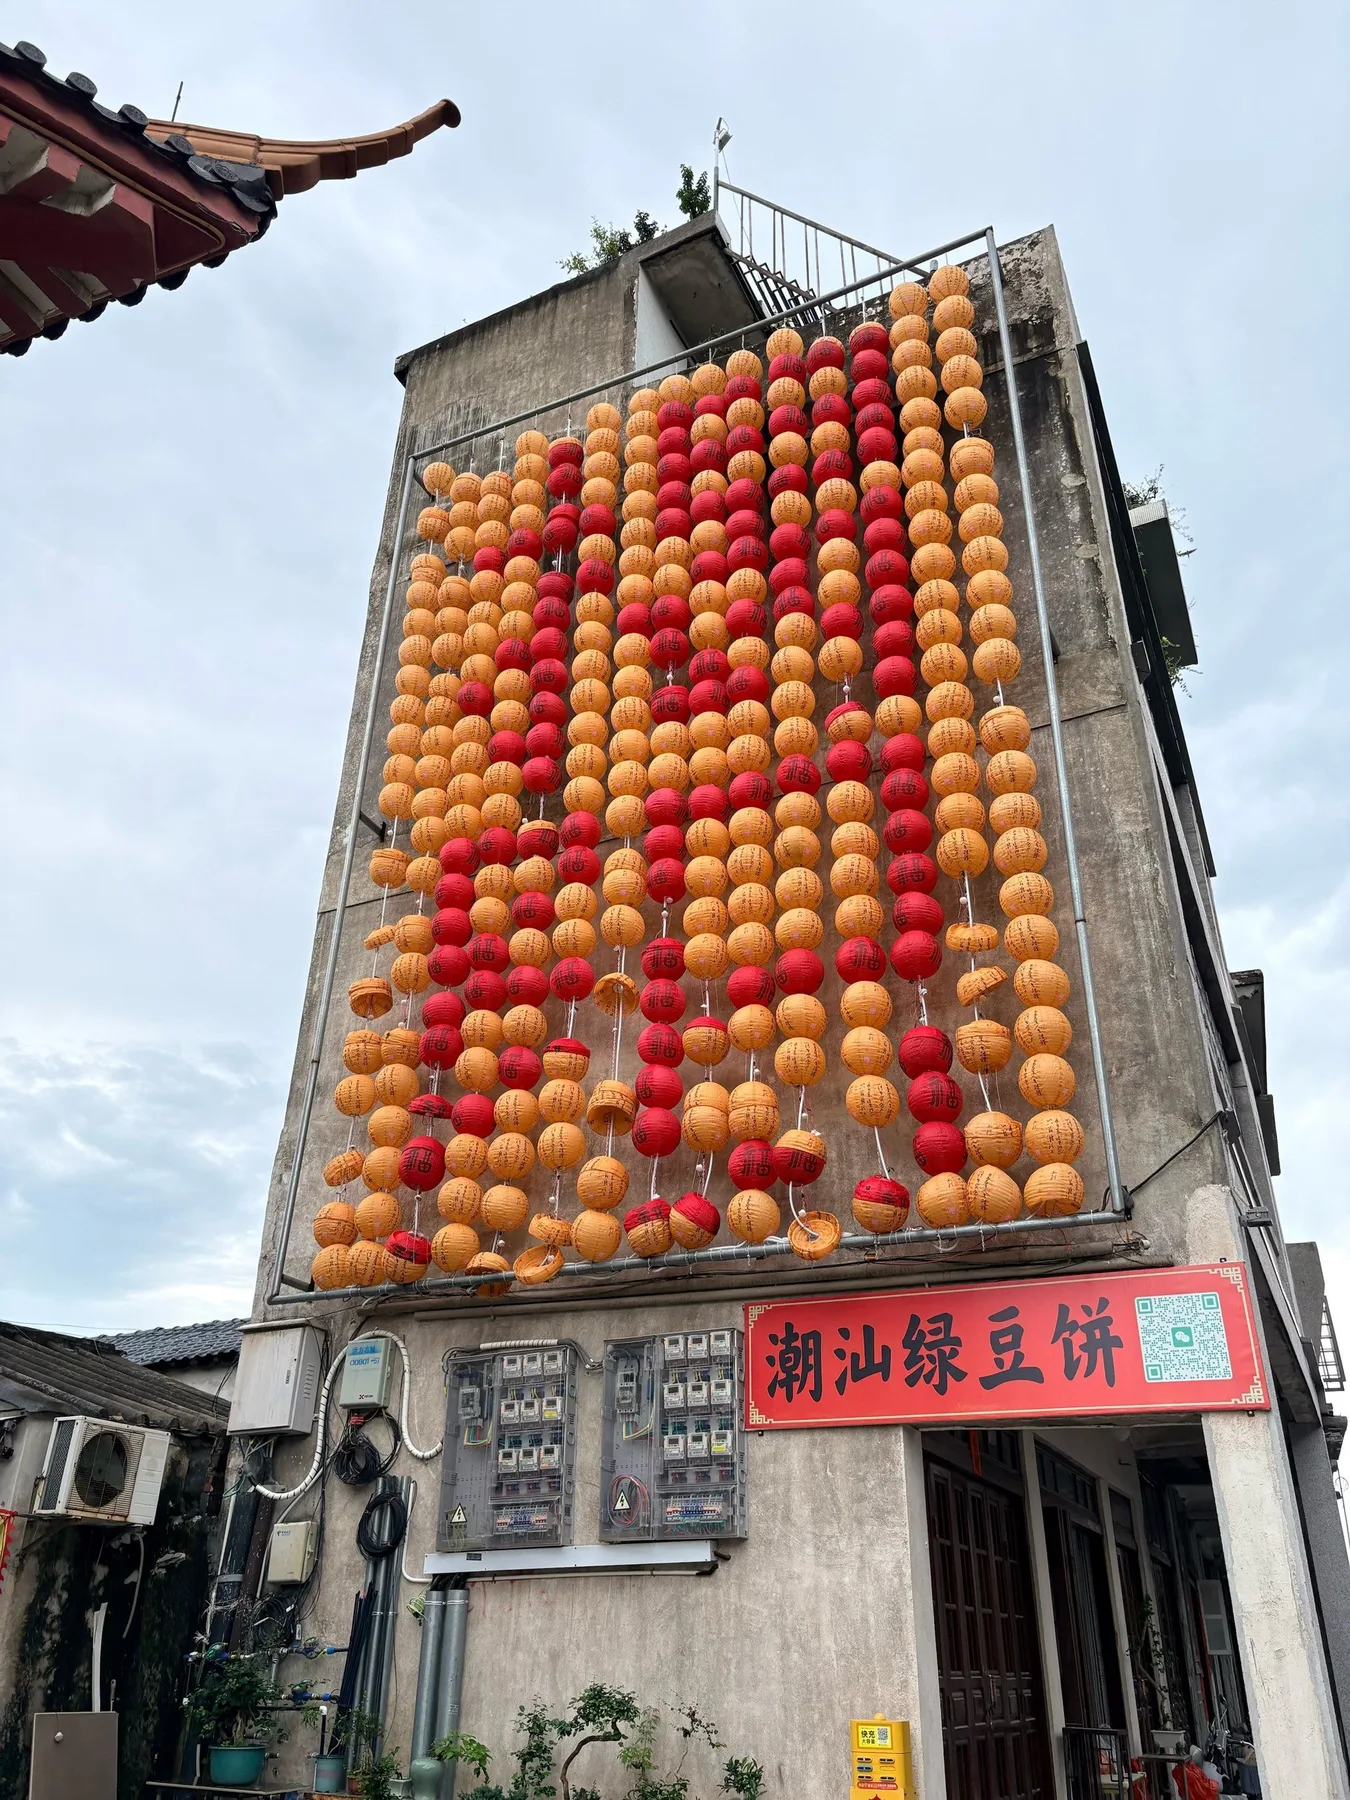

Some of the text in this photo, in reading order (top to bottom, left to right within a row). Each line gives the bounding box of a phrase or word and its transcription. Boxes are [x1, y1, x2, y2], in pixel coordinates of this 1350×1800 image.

[656, 630, 682, 653] 福
[694, 651, 720, 677] 福
[655, 692, 681, 714] 福
[784, 757, 812, 785] 福
[888, 770, 917, 796] 福
[896, 857, 926, 886] 福
[471, 936, 499, 962] 福
[650, 944, 679, 969] 福
[852, 938, 881, 971] 福
[647, 980, 676, 1009] 福
[424, 1027, 449, 1051] 福
[648, 1028, 678, 1059] 福
[928, 1072, 960, 1110] 福
[405, 1147, 433, 1174] 福
[741, 1145, 773, 1177] 福
[766, 1296, 1124, 1403] 潮汕绿豆饼
[861, 1730, 875, 1738] 快充
